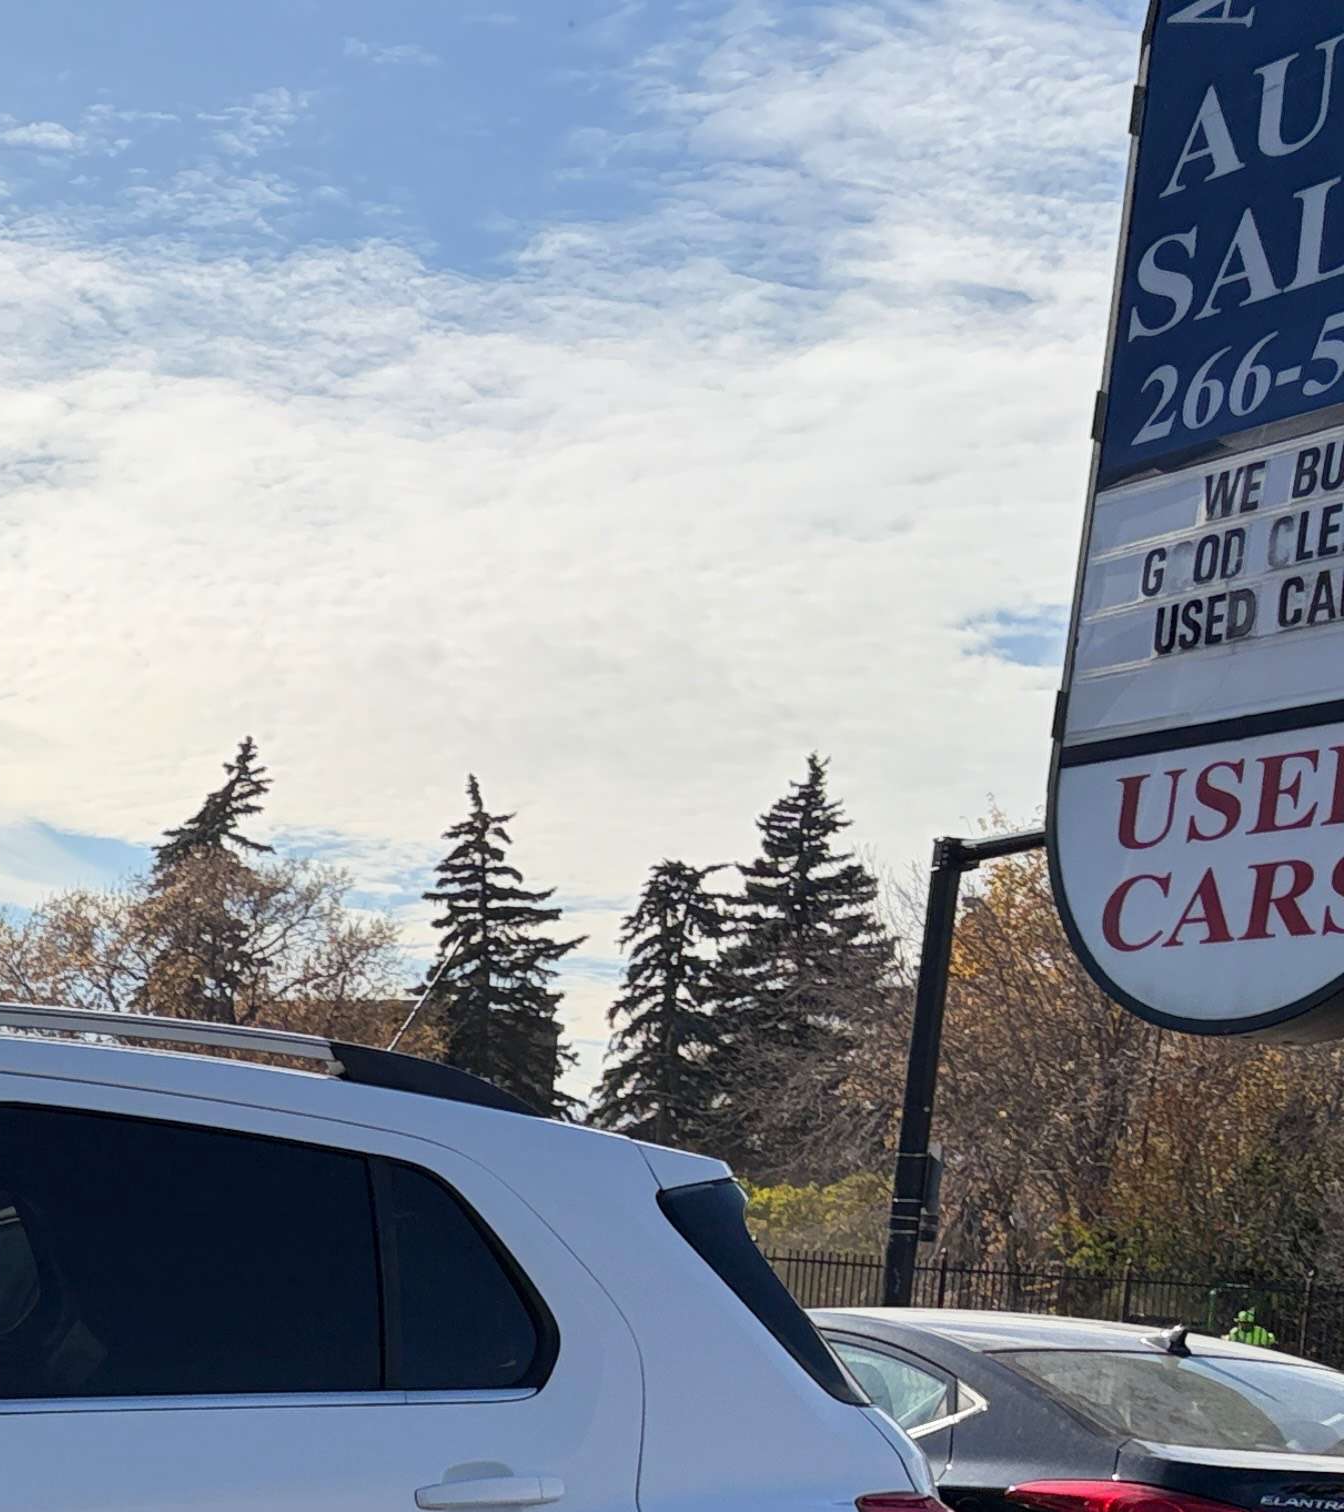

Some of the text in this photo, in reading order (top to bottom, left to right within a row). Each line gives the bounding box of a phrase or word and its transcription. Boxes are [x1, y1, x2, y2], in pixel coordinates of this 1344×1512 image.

[1205, 460, 1266, 521] WE
[1154, 569, 1344, 656] USED CA
